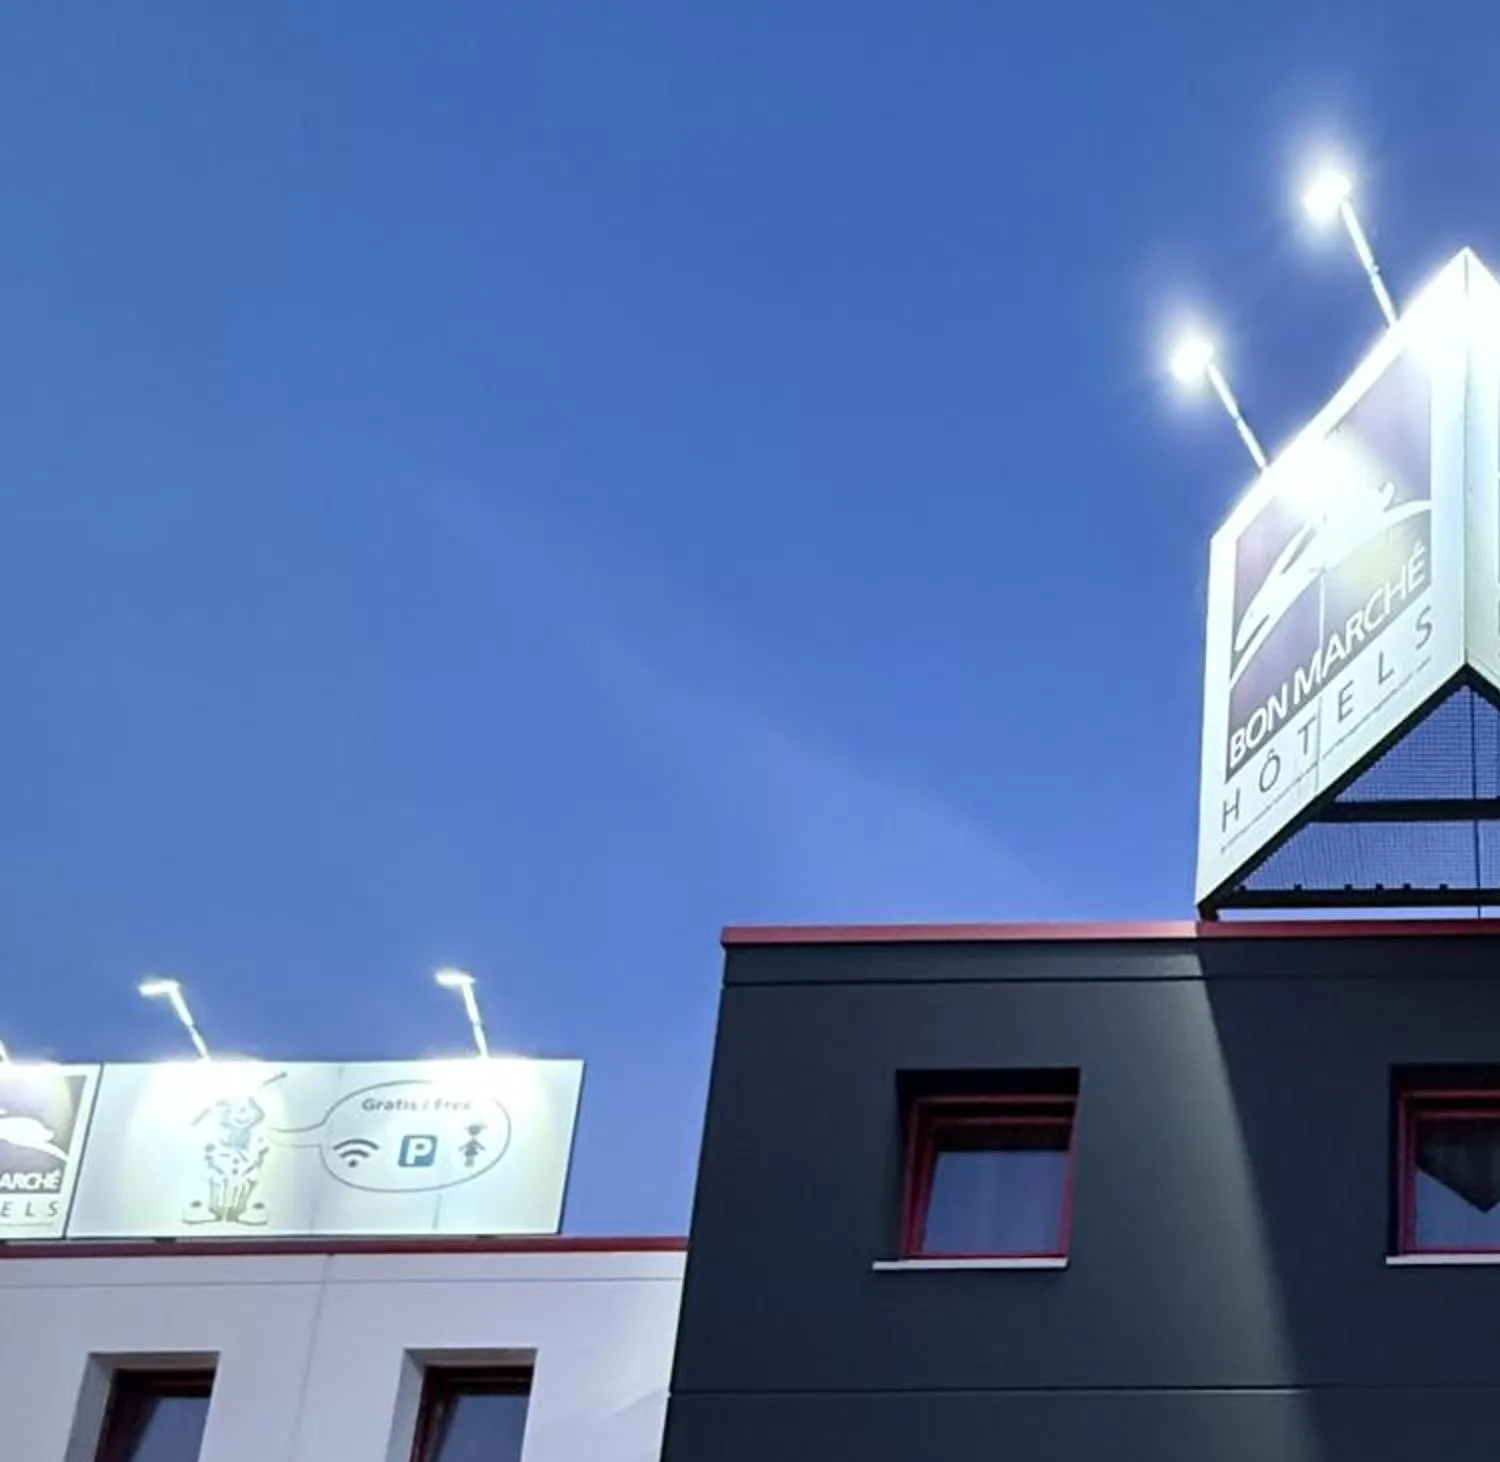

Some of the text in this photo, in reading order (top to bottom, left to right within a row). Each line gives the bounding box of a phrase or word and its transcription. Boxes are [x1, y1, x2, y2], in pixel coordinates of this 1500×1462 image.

[1221, 604, 1433, 833] HÔTELS
[1229, 540, 1426, 769] BON MARCHÉ
[361, 1098, 418, 1111] Gratis
